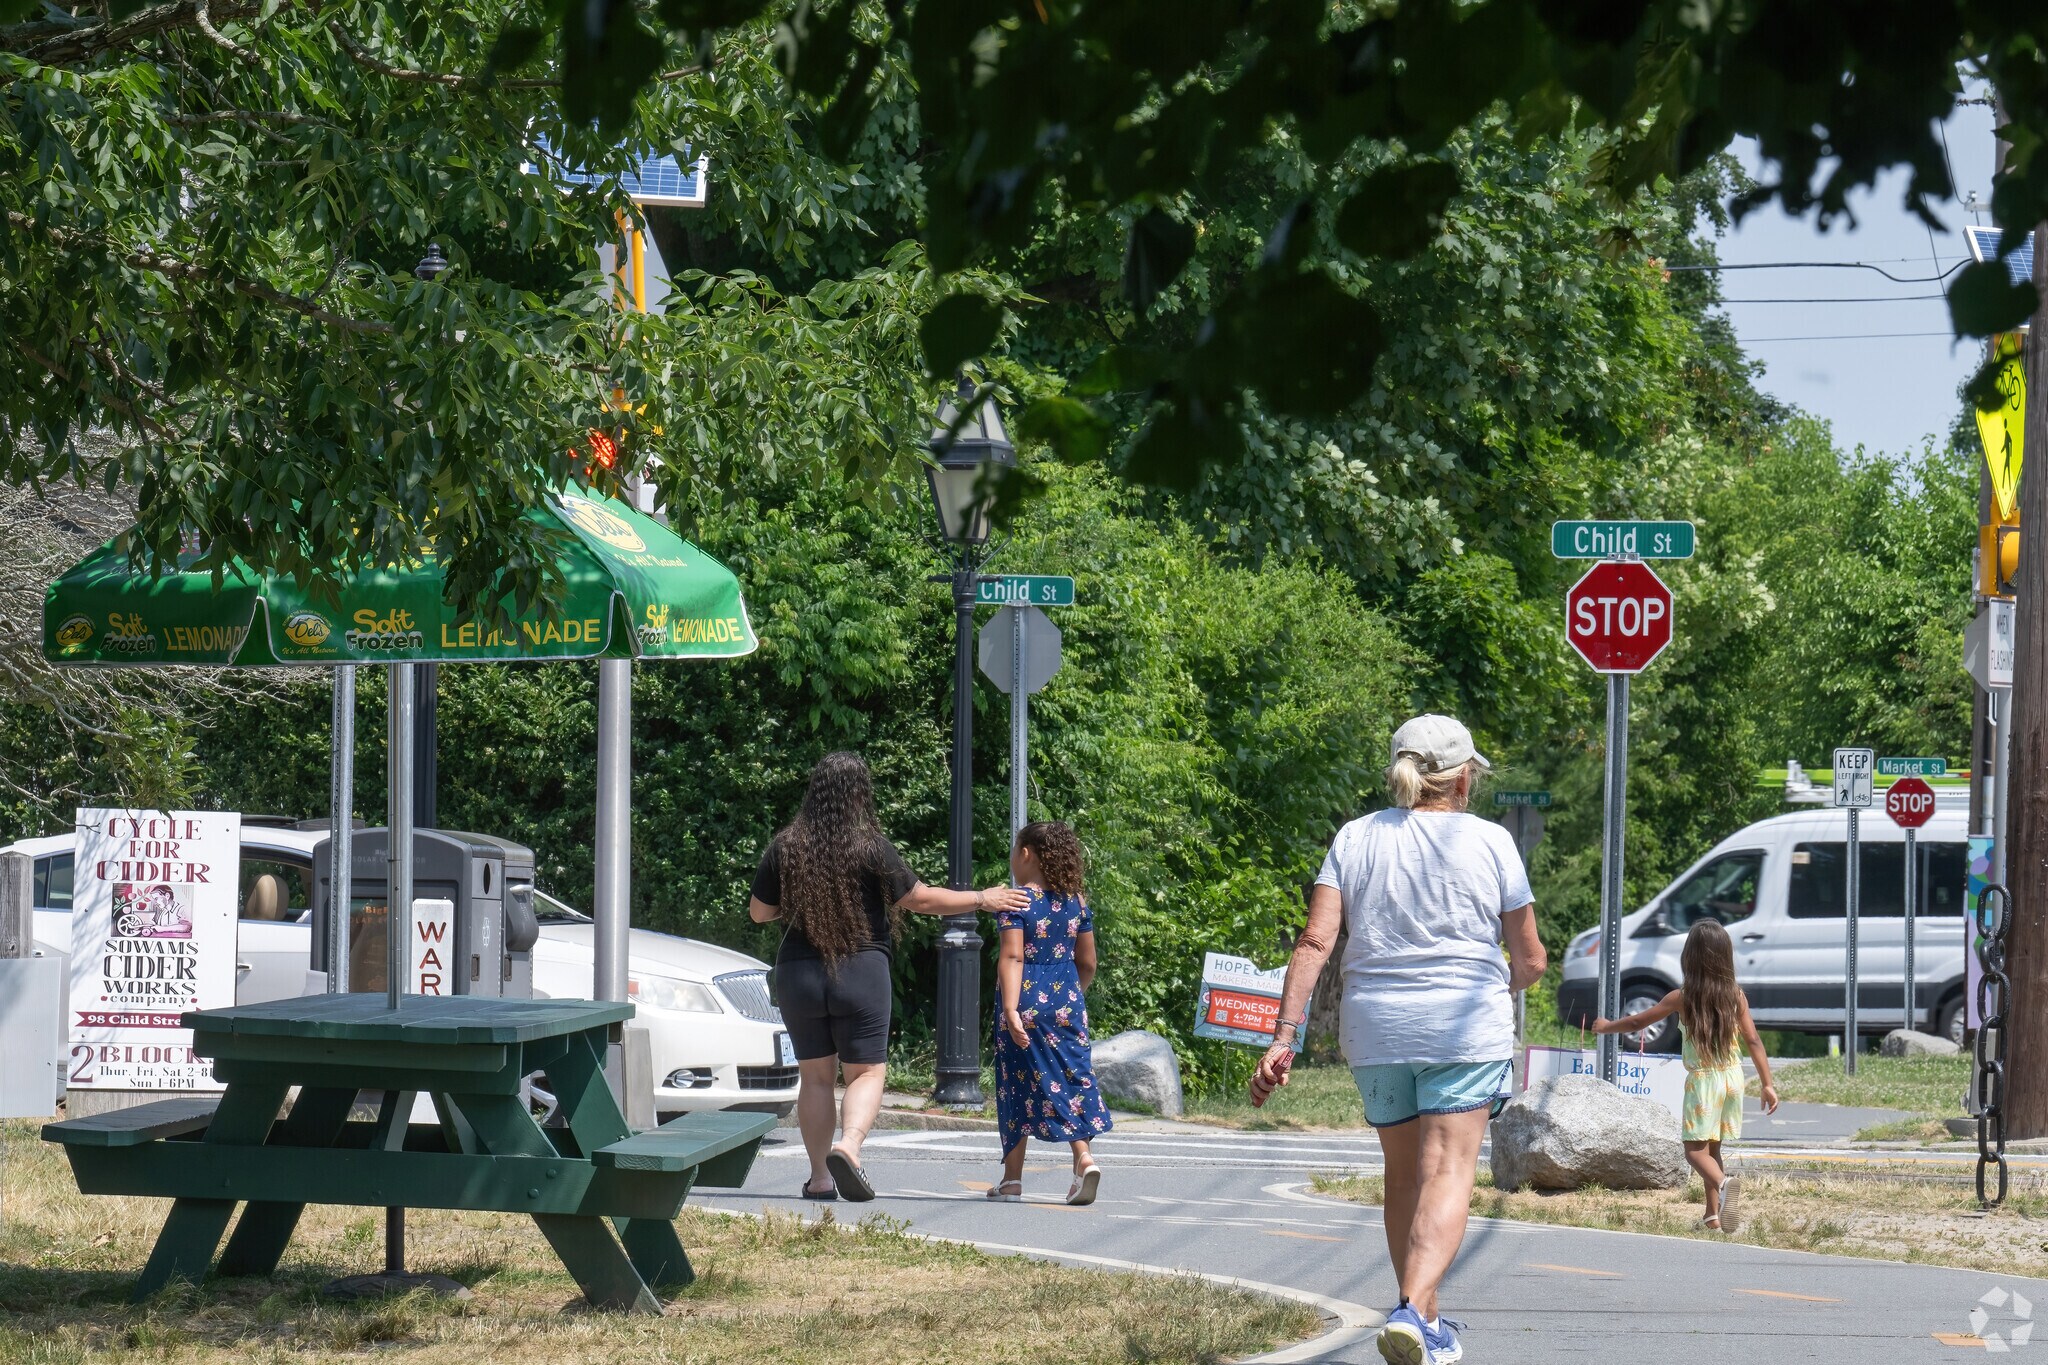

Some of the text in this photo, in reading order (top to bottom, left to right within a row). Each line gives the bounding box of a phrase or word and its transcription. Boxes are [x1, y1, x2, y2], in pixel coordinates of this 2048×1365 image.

[1574, 526, 1672, 554] Child St
[981, 580, 1057, 601] Child St
[108, 612, 148, 638] Soft
[353, 608, 415, 636] Soft
[646, 604, 669, 629] Soft
[1574, 597, 1665, 637] STOP
[1996, 614, 2010, 635] WHEN
[637, 625, 668, 646] Frozen
[672, 618, 744, 643] LEMONADE
[100, 633, 157, 654] Frozen
[345, 631, 424, 652] Frozen
[1990, 649, 2014, 672] FLASHING
[1839, 755, 1868, 769] KEEP
[1883, 760, 1941, 774] Market St
[1498, 793, 1547, 804] Market St
[1889, 793, 1933, 812] STOP
[108, 817, 202, 841] CYCLE
[129, 840, 181, 859] FOR
[96, 860, 212, 884] CIDER
[105, 940, 199, 955] SOWAMS
[417, 921, 447, 995] WAR
[103, 955, 198, 981] CIDER
[1214, 958, 1251, 975] HOPE
[102, 980, 197, 996] WORKS
[1212, 974, 1283, 992] MAKERS MARK
[110, 995, 188, 1007] company
[1214, 996, 1280, 1016] WEDNESDA
[88, 1014, 182, 1026] 98 Child Stre
[1234, 1012, 1262, 1024] 4-7PM
[70, 1045, 213, 1083] 2 BLOCK
[162, 1067, 182, 1078] Sat
[188, 1067, 213, 1078] 2-8
[1571, 1058, 1651, 1084] Ea Bay
[130, 1078, 154, 1088] Sun
[1616, 1082, 1651, 1096] tudio
